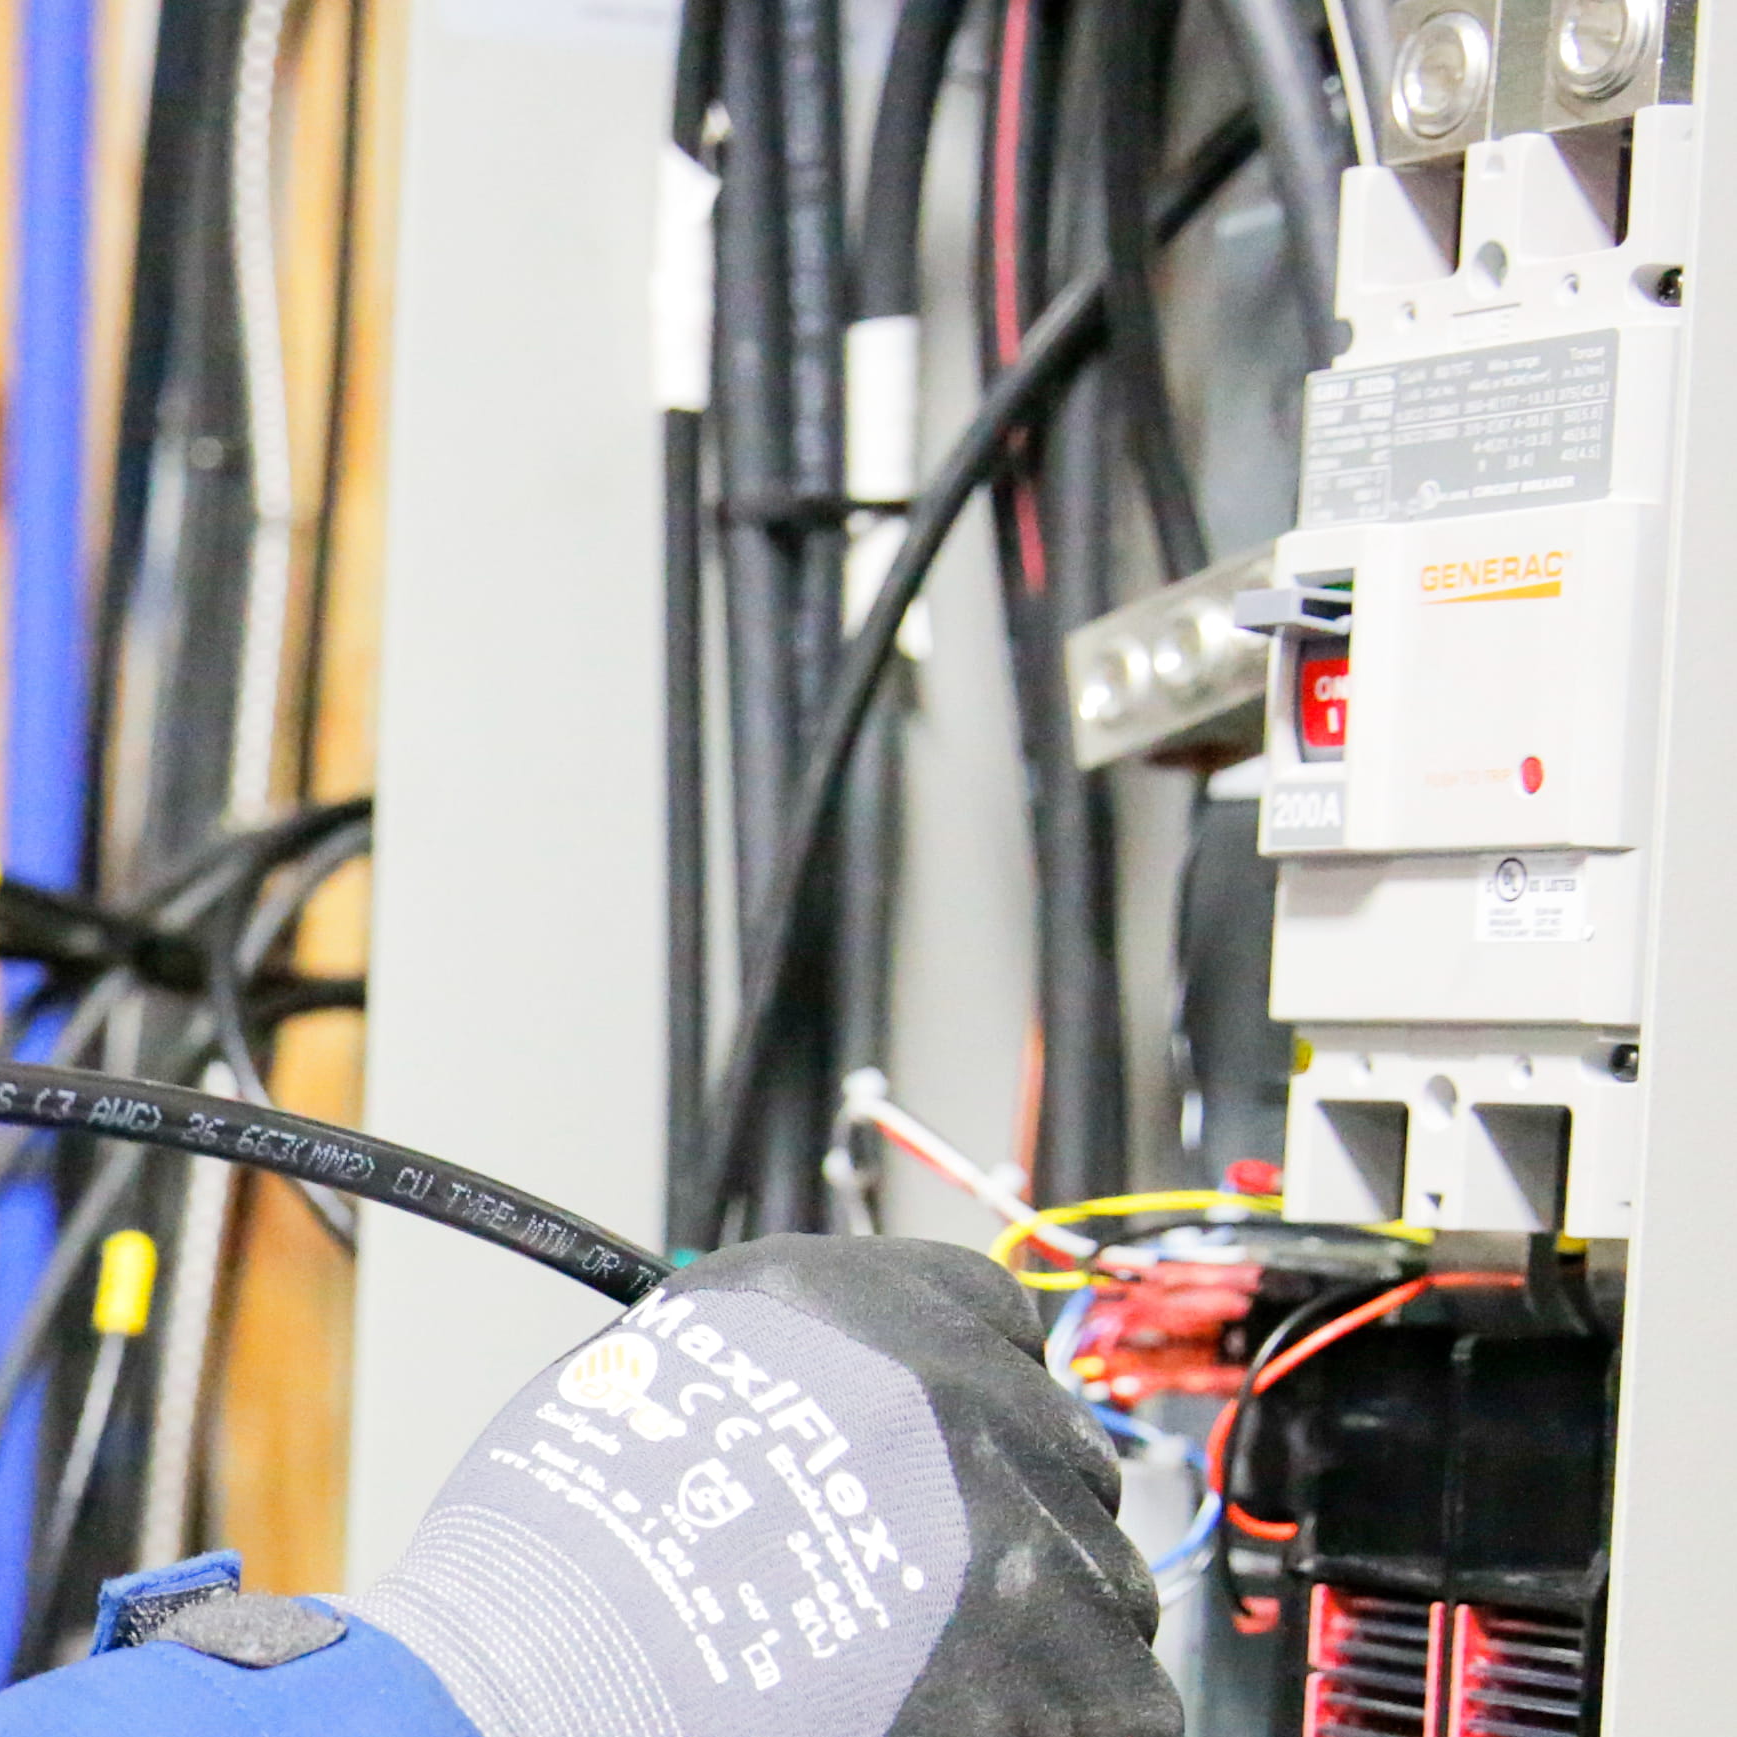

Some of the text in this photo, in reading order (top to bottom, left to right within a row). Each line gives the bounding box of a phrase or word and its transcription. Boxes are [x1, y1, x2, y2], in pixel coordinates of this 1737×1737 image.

[1421, 550, 1563, 592] GENERAC
[1272, 792, 1341, 829] 200A
[582, 1245, 620, 1279] OR
